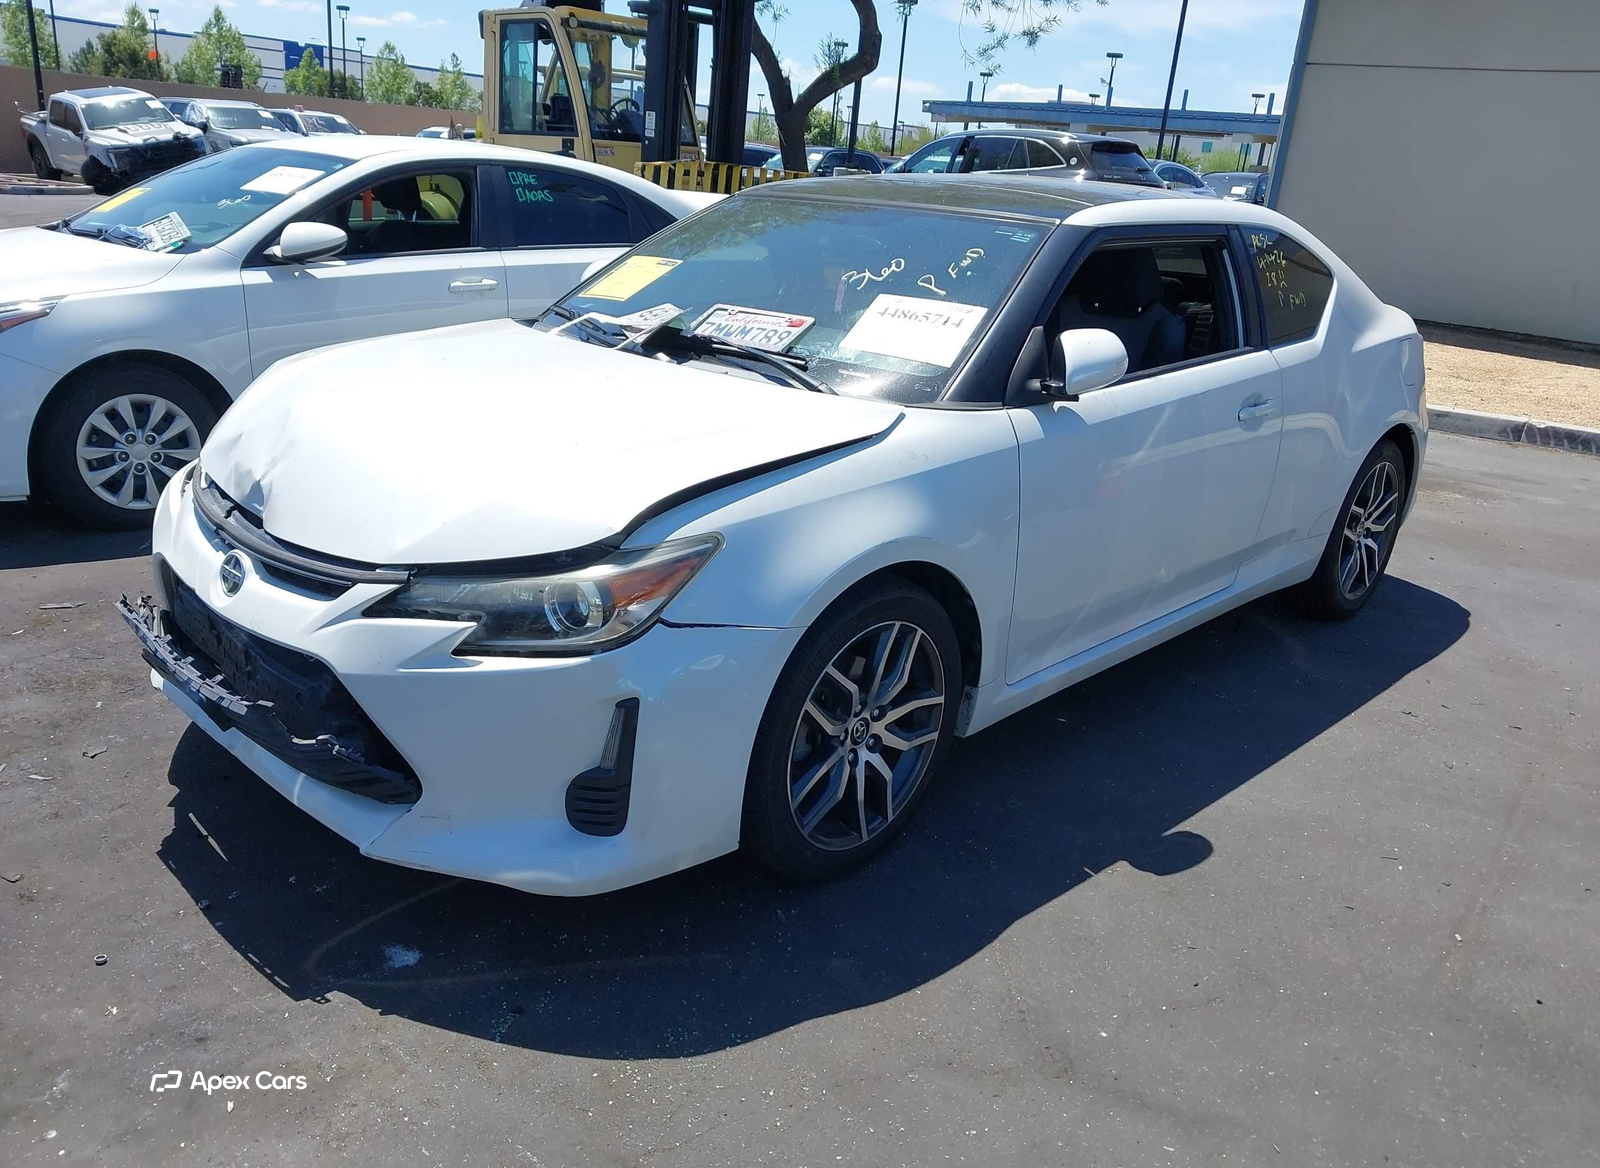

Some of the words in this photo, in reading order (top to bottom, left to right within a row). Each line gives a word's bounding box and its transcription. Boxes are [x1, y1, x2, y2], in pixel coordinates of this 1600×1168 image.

[725, 313, 785, 328] California
[877, 307, 965, 328] 44865714
[701, 321, 793, 346] 7MWM789
